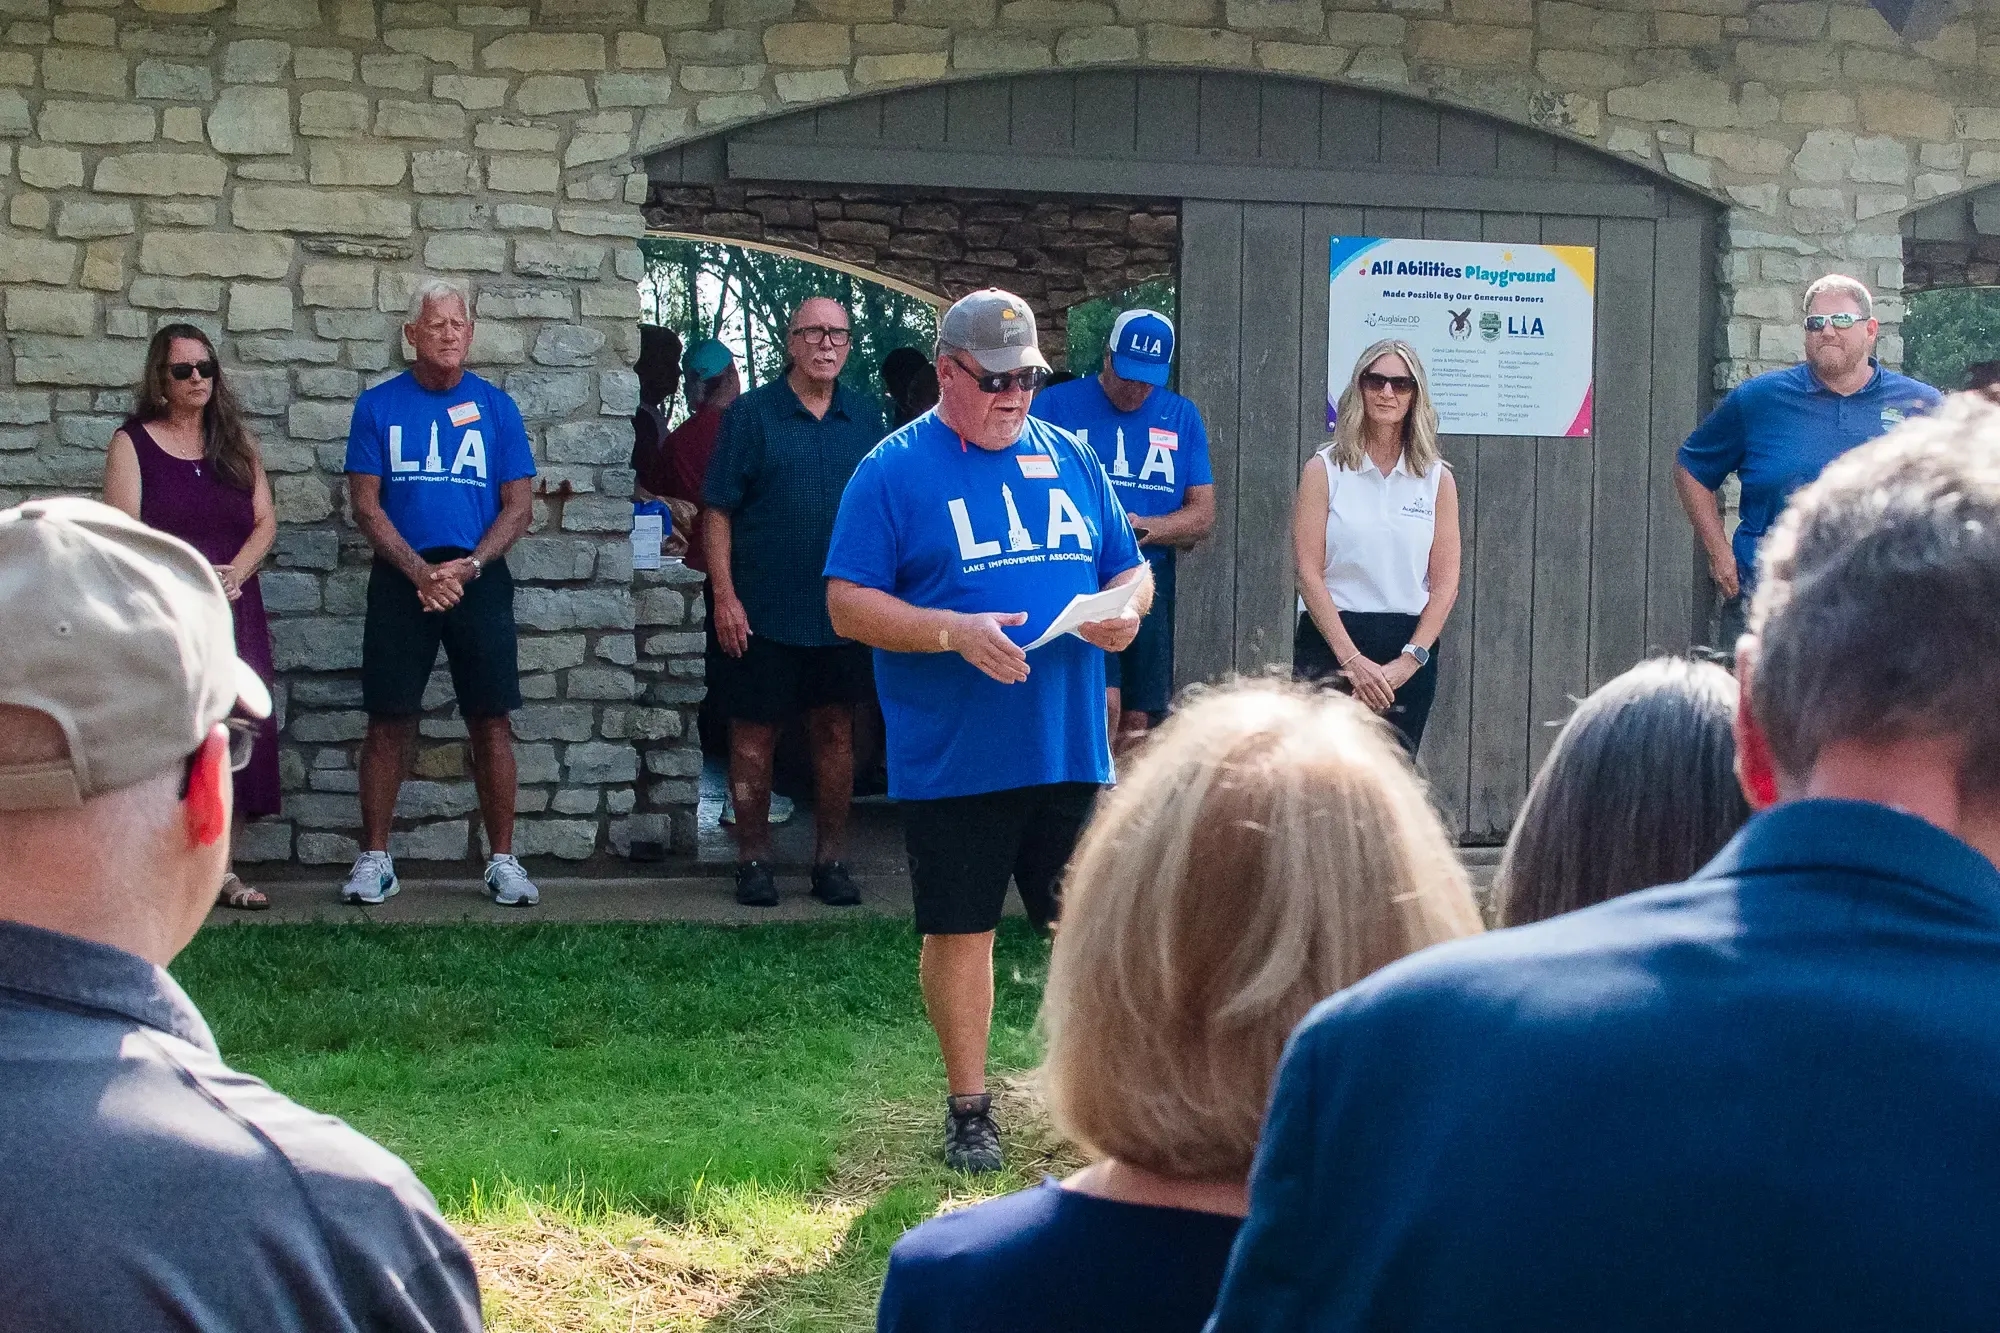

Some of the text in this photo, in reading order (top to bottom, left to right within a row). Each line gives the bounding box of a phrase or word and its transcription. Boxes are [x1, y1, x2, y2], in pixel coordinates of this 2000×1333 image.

[1371, 261, 1556, 287] All Abilities Playground
[1382, 290, 1544, 303] Made Possible By Our Generous Donors
[1378, 315, 1420, 324] Auglaize DD
[450, 477, 487, 488] ASSOCIATION
[1138, 483, 1174, 494] ASSOCIATION
[963, 563, 985, 574] LAKE
[988, 554, 1046, 569] IMPROVEMENT
